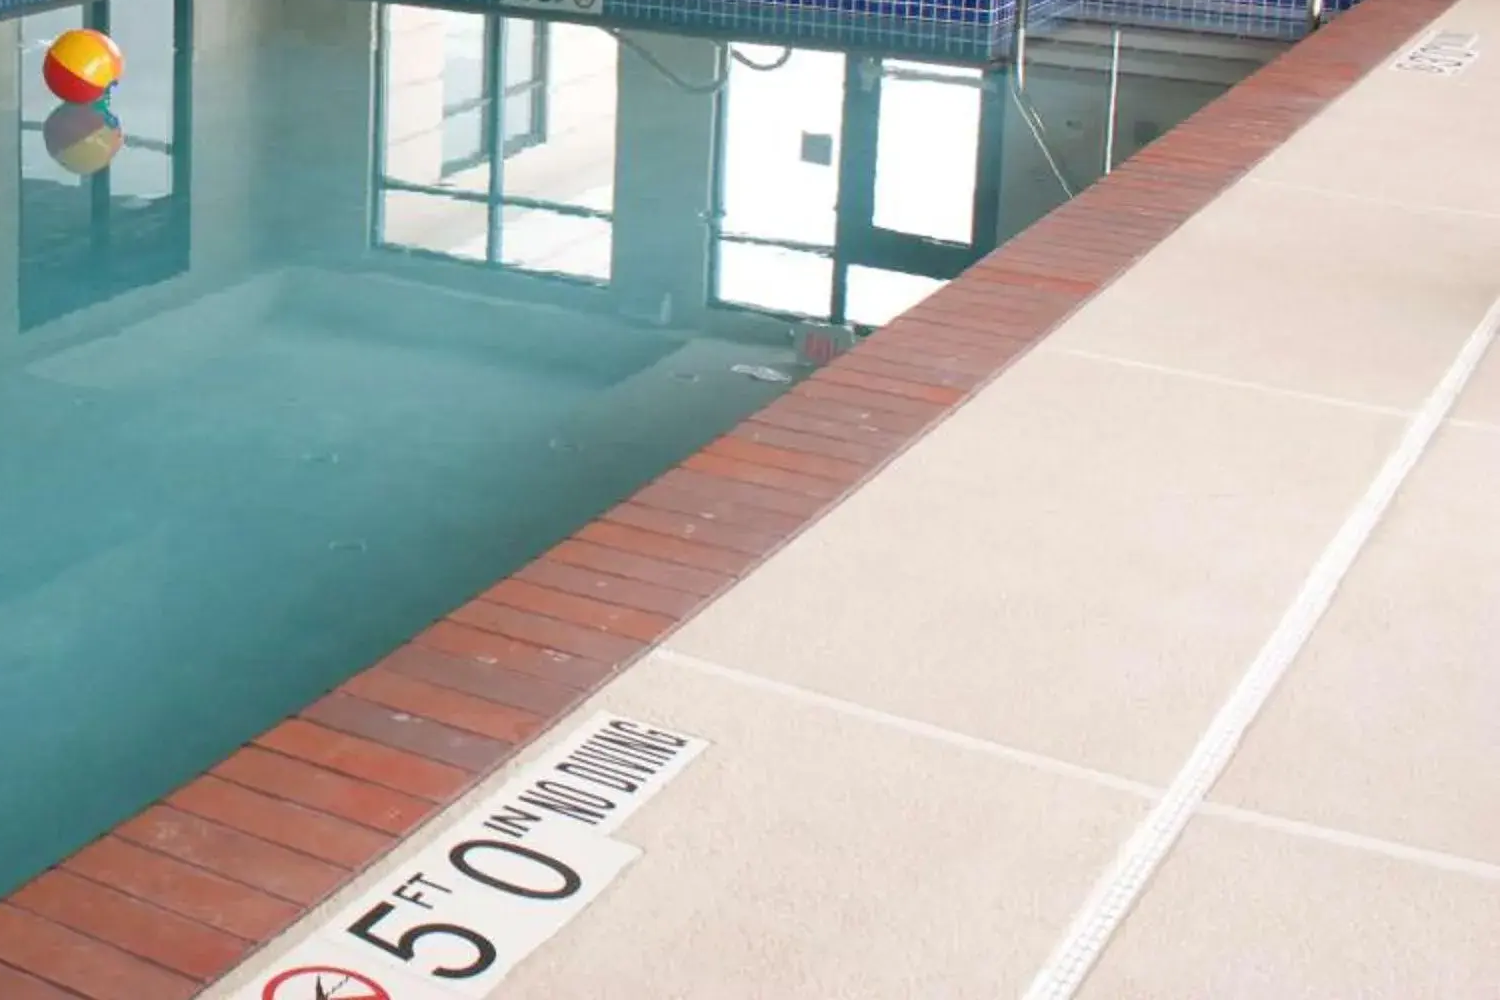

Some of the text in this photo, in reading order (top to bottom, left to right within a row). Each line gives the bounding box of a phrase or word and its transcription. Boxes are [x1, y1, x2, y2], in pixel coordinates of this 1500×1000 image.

[347, 719, 688, 979] 5 FT 0 IN NO DIVING
